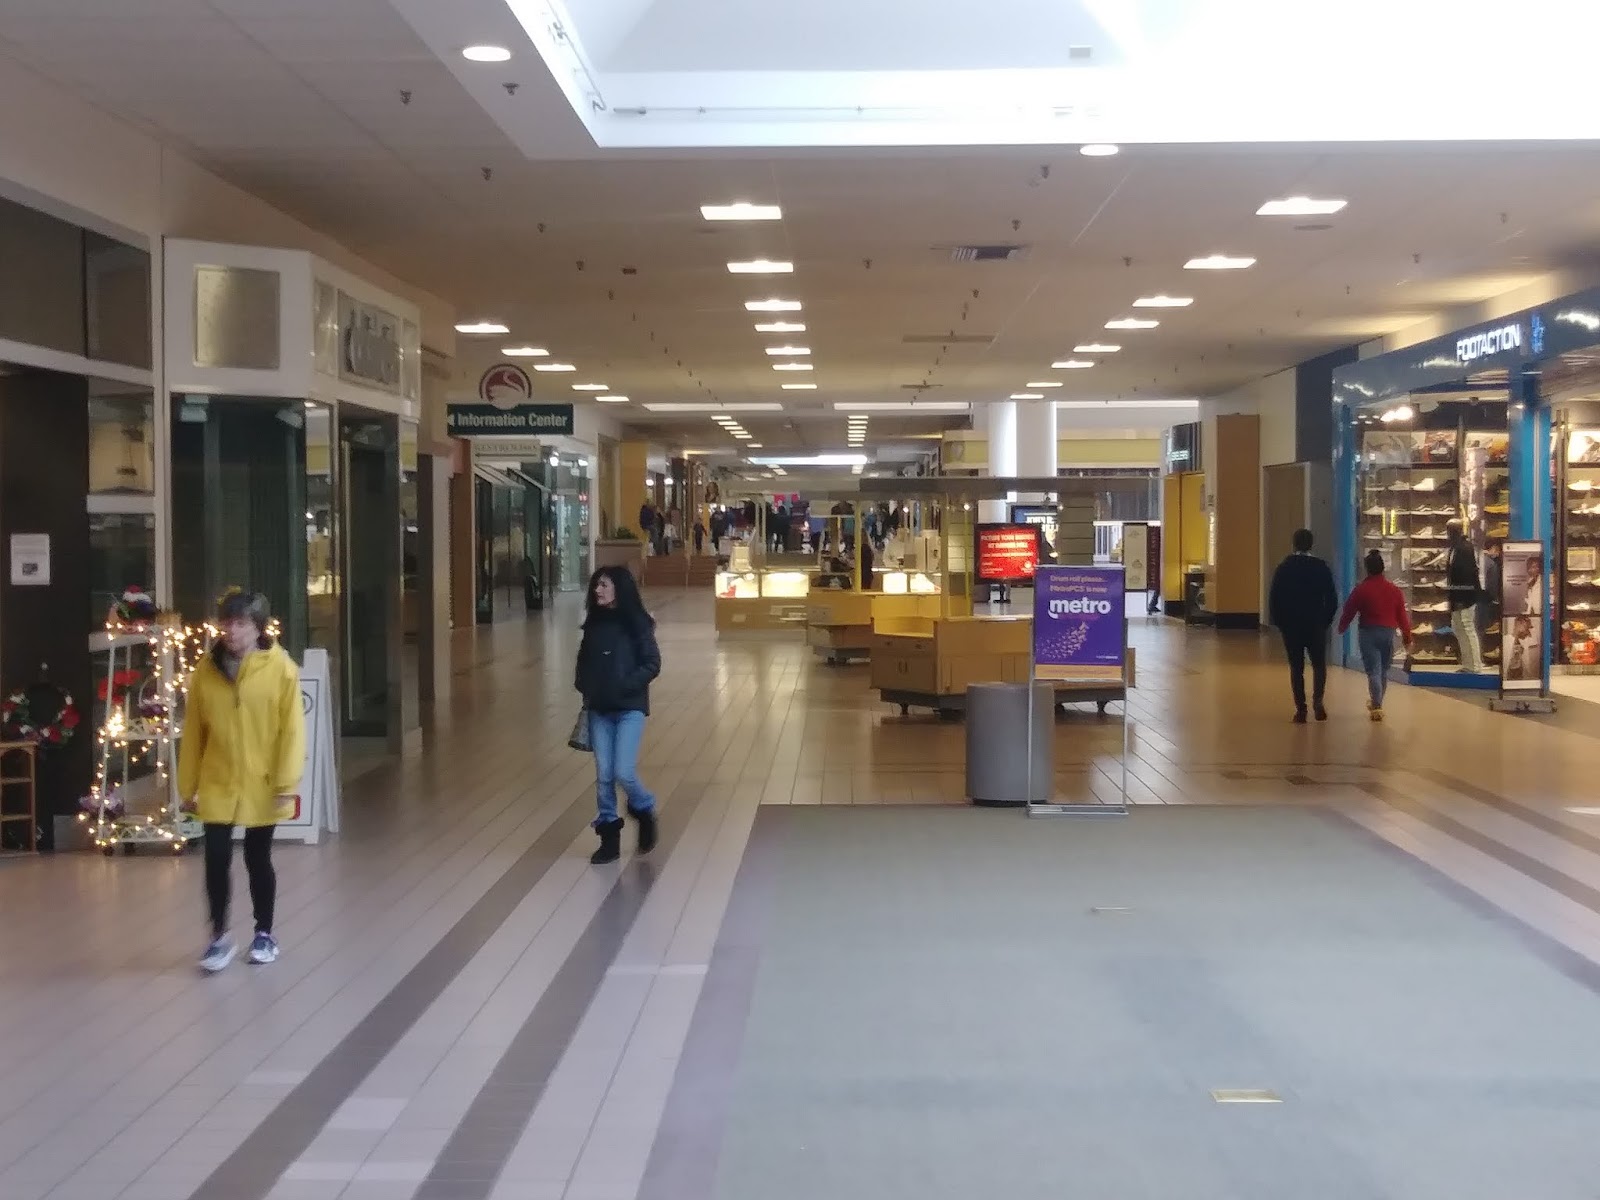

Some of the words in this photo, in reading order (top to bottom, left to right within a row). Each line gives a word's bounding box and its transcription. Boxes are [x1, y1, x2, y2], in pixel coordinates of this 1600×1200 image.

[1456, 323, 1521, 361] FOOTACTION
[457, 412, 526, 427] Information
[528, 411, 568, 427] Center
[1048, 596, 1112, 619] metro
